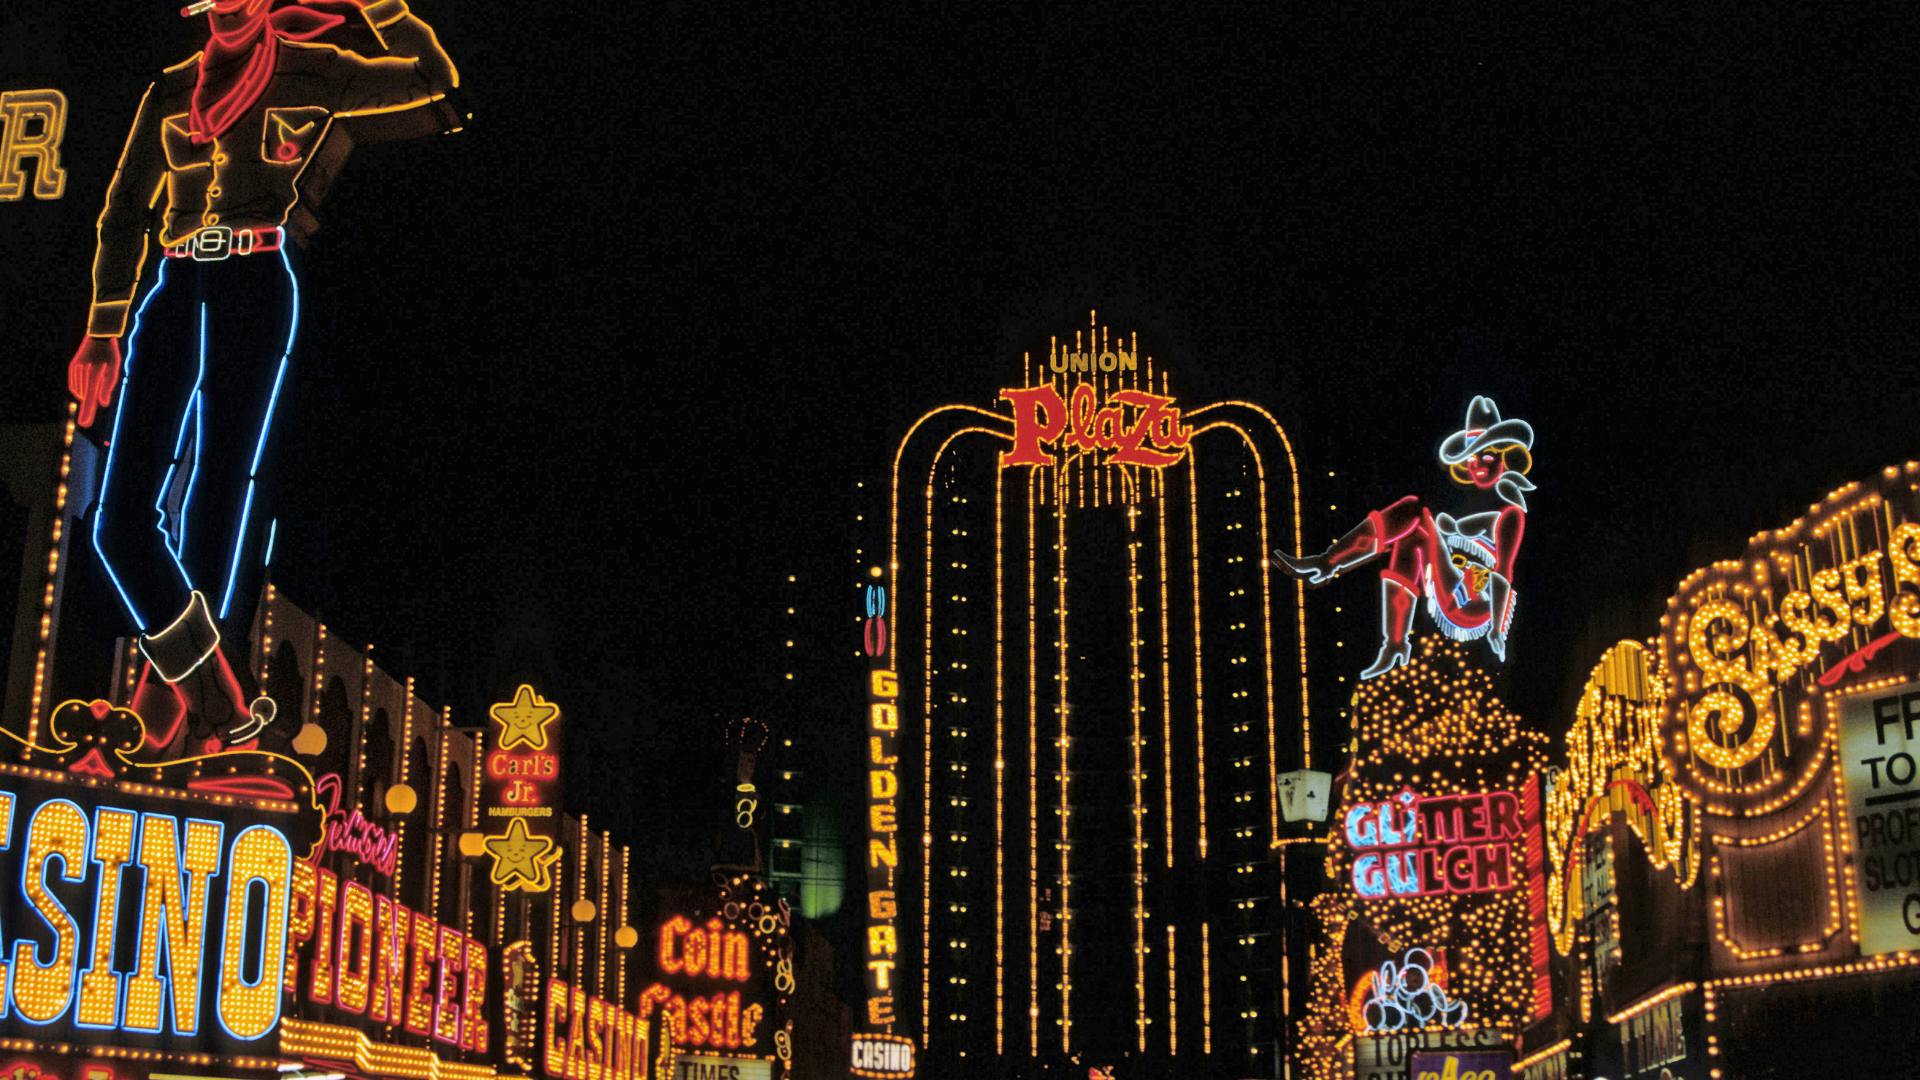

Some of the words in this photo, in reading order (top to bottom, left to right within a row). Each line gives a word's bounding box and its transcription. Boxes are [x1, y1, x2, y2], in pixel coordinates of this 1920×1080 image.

[1050, 351, 1138, 373] UNION
[1000, 382, 1193, 467] Plaza
[491, 753, 555, 777] Carl's
[506, 779, 537, 803] Jr.
[868, 669, 898, 868] GOLDEN
[488, 806, 553, 817] HAMBURGERS
[1353, 842, 1514, 898] GULCH
[0, 789, 292, 1041] SINO
[657, 914, 752, 983] Coin
[284, 857, 488, 1053] PIONEER
[867, 890, 897, 1025] GATE
[544, 977, 650, 1080] CASINO
[851, 1039, 912, 1073] CASINO
